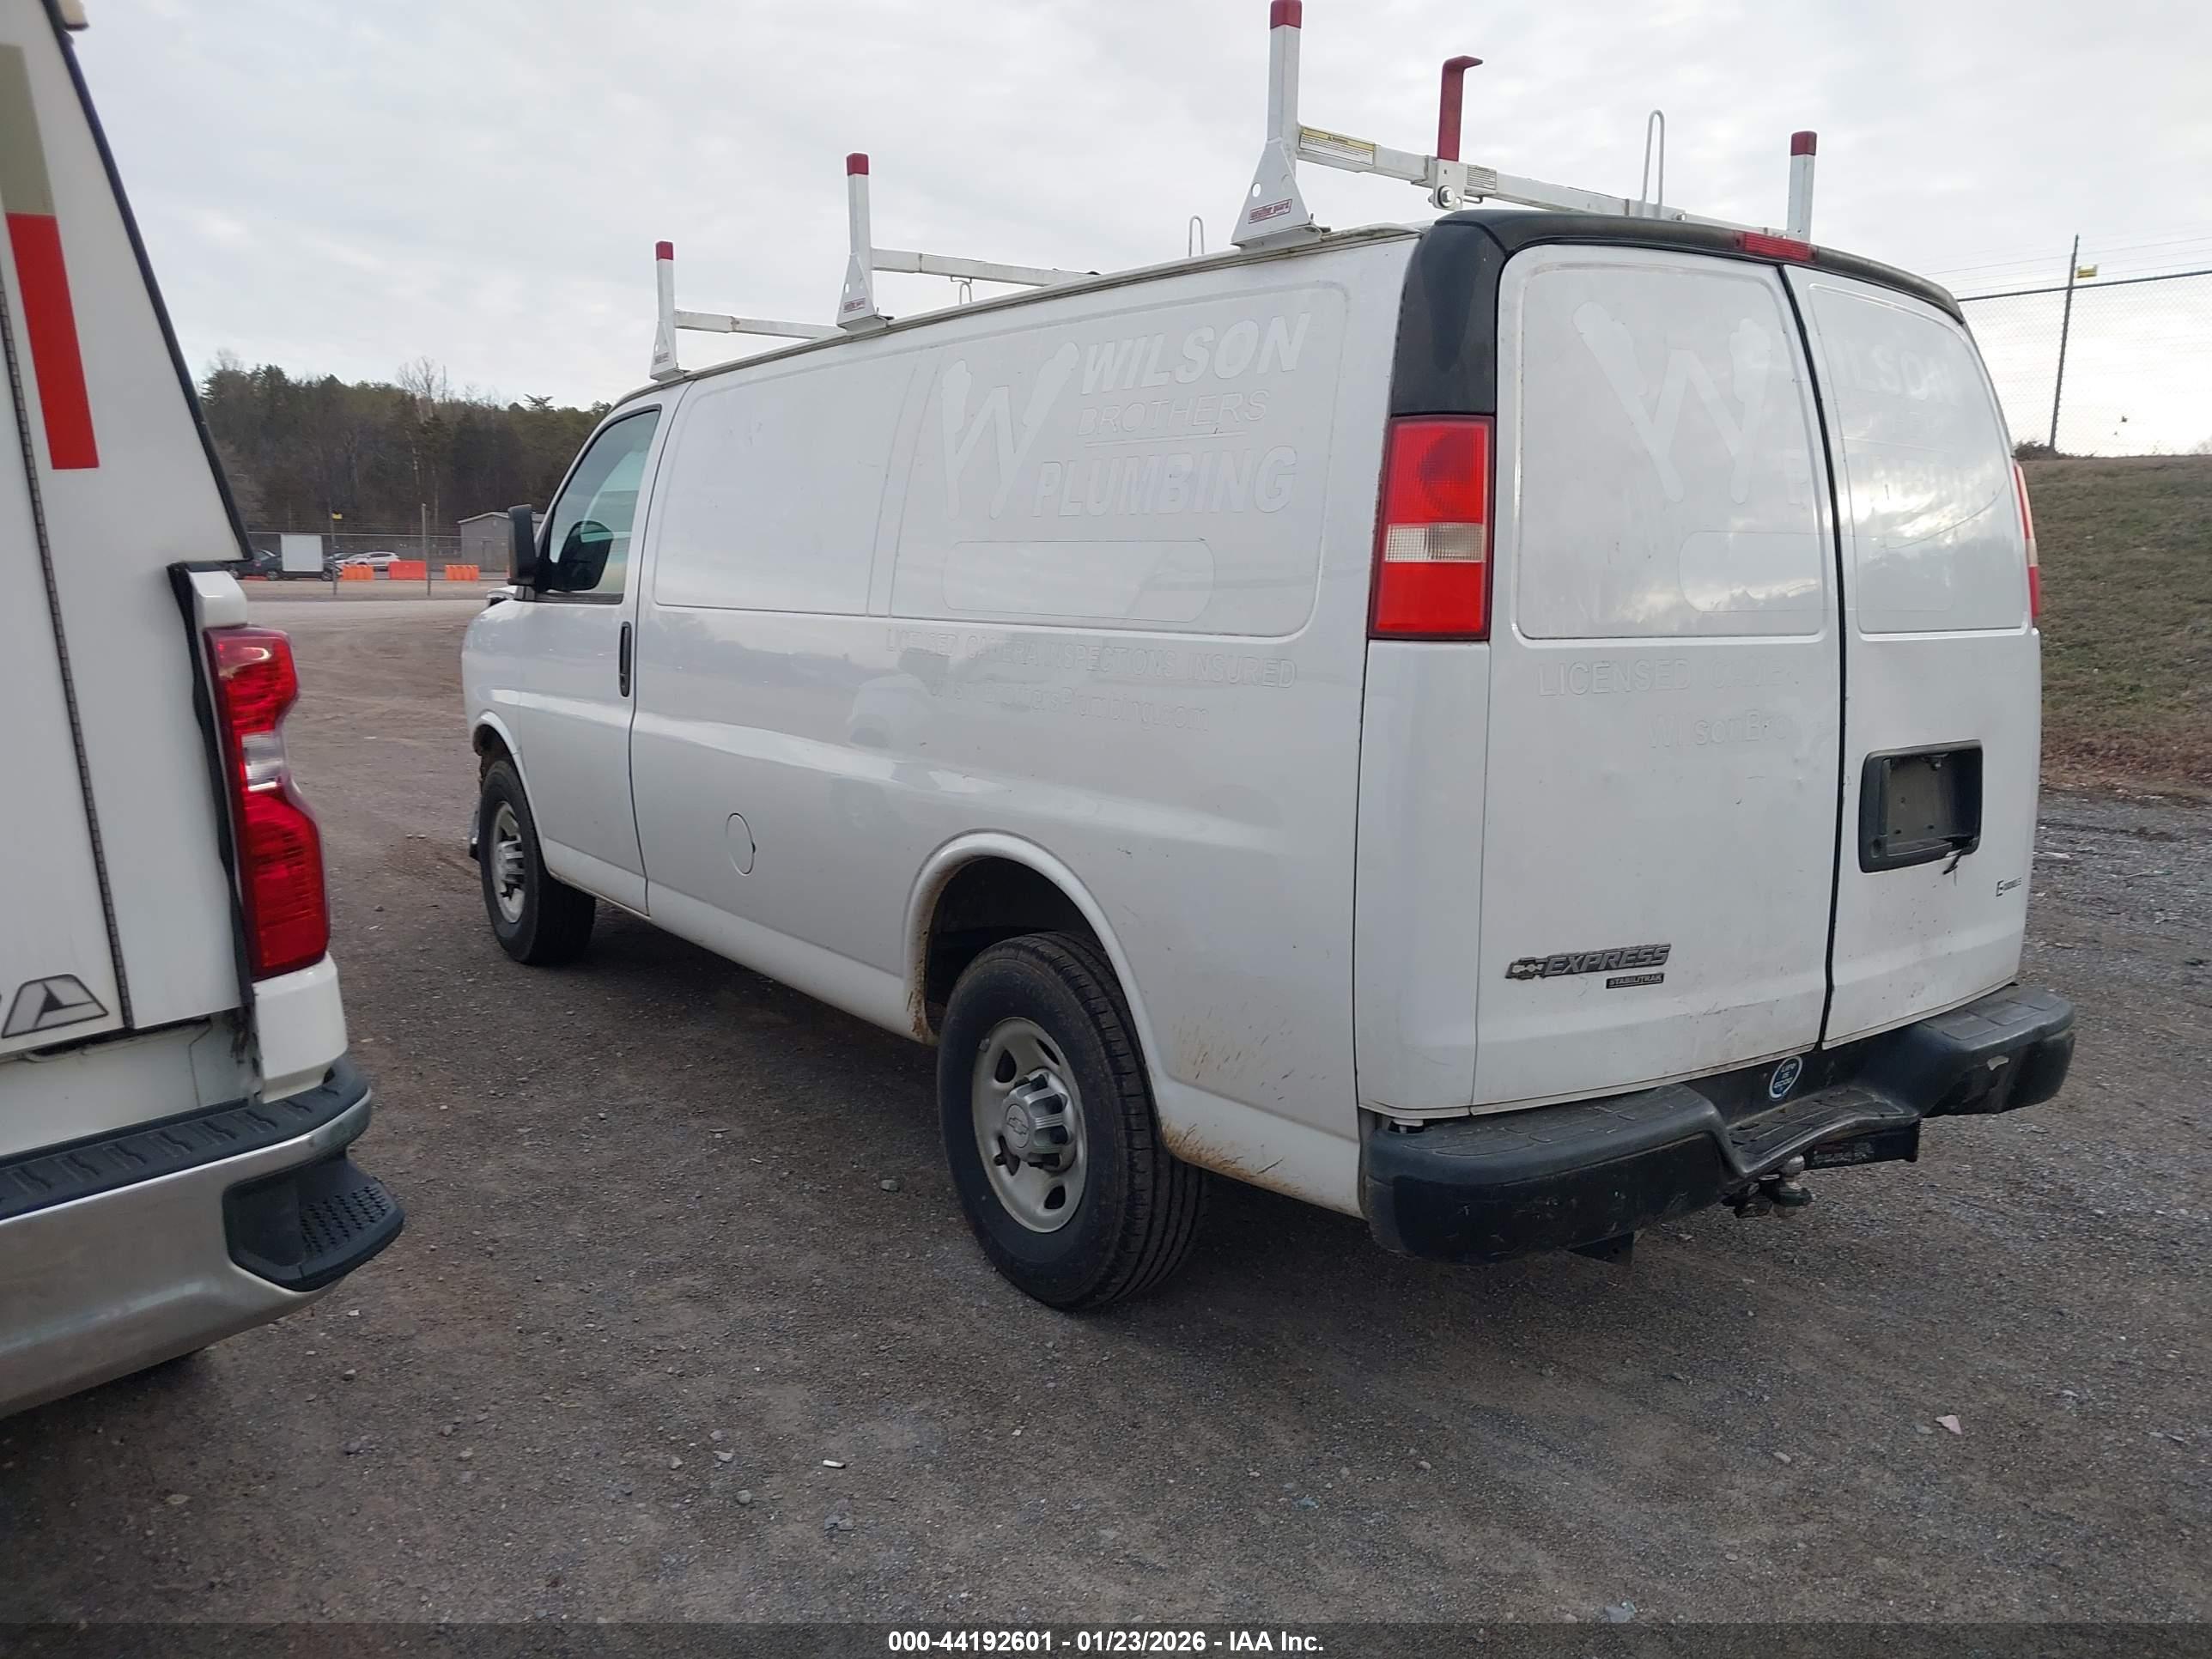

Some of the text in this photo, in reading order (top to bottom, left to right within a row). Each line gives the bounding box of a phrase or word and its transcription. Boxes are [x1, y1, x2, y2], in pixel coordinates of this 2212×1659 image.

[1079, 312, 1313, 398] WILSON
[1078, 389, 1270, 436] BROTHERS
[1030, 444, 1298, 519] PLUMBING
[1188, 653, 1298, 690] INSURED
[1536, 658, 1692, 697] LICENSED
[1546, 945, 1671, 975] EXPRESS
